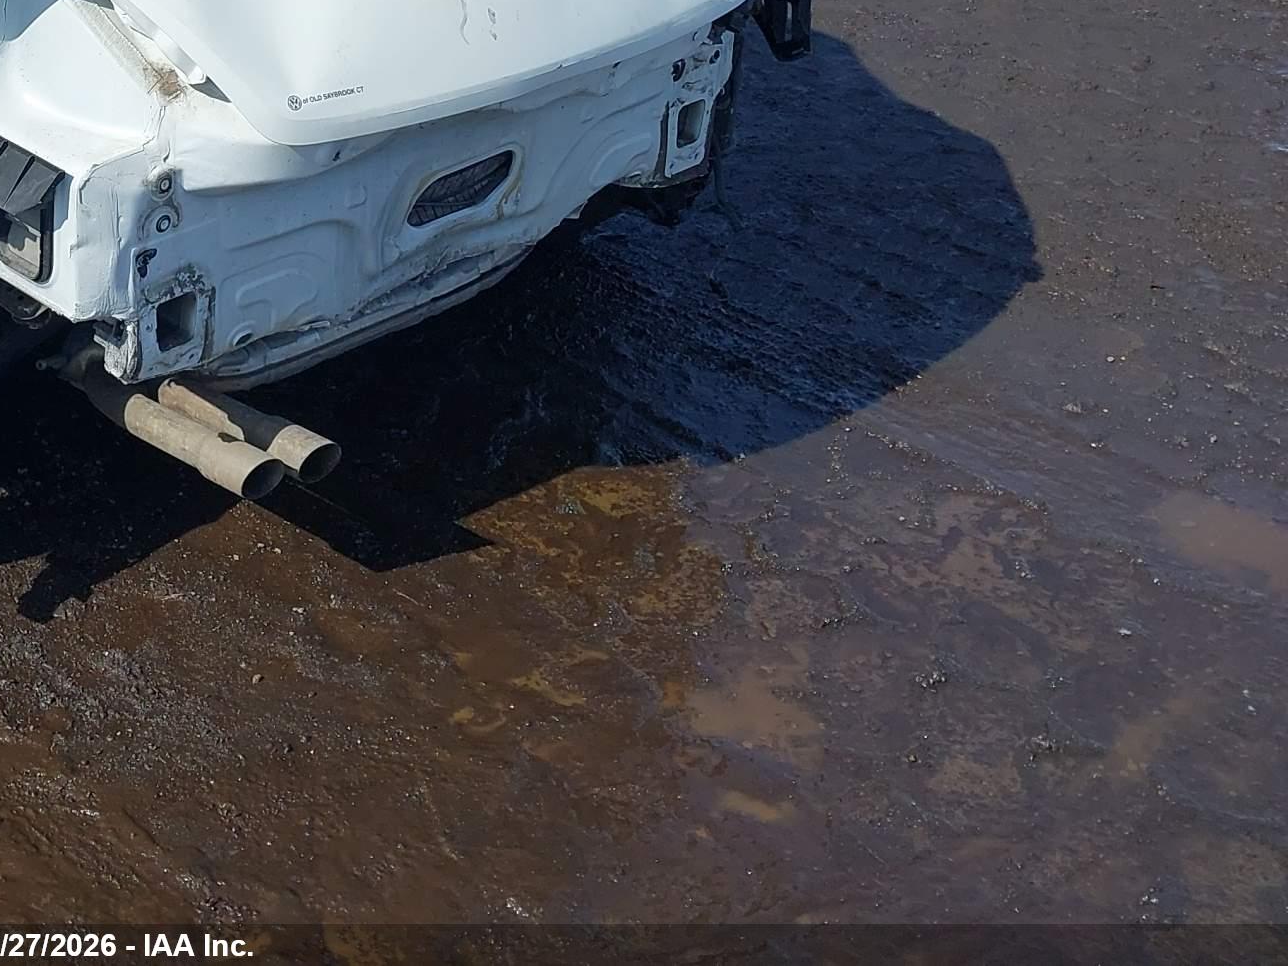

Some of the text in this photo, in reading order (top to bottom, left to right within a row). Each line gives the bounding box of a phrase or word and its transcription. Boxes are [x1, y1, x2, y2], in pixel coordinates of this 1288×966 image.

[309, 95, 323, 103] OLD
[323, 88, 355, 101] SAYBROOK
[356, 86, 364, 94] CT
